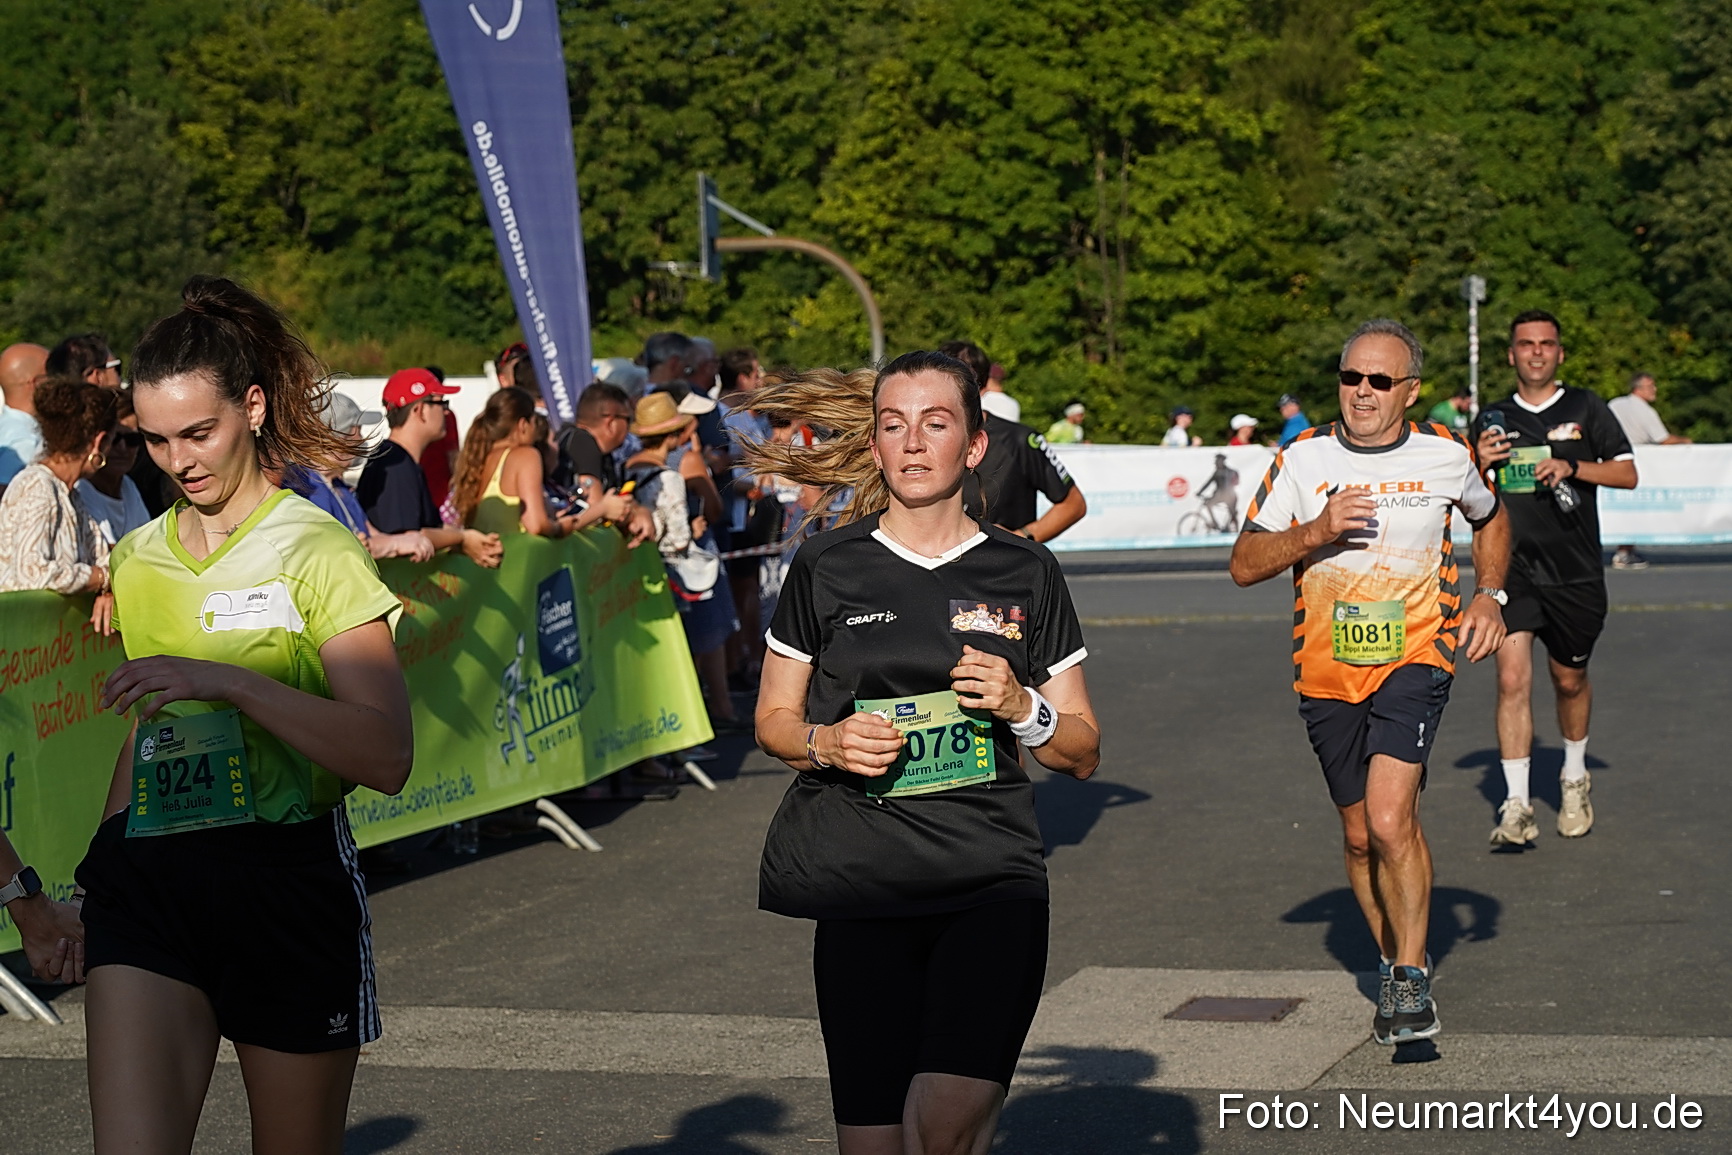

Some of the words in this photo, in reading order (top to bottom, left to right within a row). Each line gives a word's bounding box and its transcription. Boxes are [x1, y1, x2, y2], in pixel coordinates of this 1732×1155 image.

[846, 612, 885, 626] CRAFT
[1341, 622, 1391, 644] 1081
[1343, 644, 1361, 653] Sippl
[1361, 644, 1392, 653] Michael
[32, 680, 88, 741] laufen
[905, 722, 971, 762] 078
[155, 753, 215, 798] 924
[228, 755, 246, 808] 2022
[894, 764, 932, 778] Sturm
[935, 759, 964, 773] Lena
[137, 777, 148, 816] RUN
[162, 799, 180, 813] Heß
[183, 796, 213, 810] Julia
